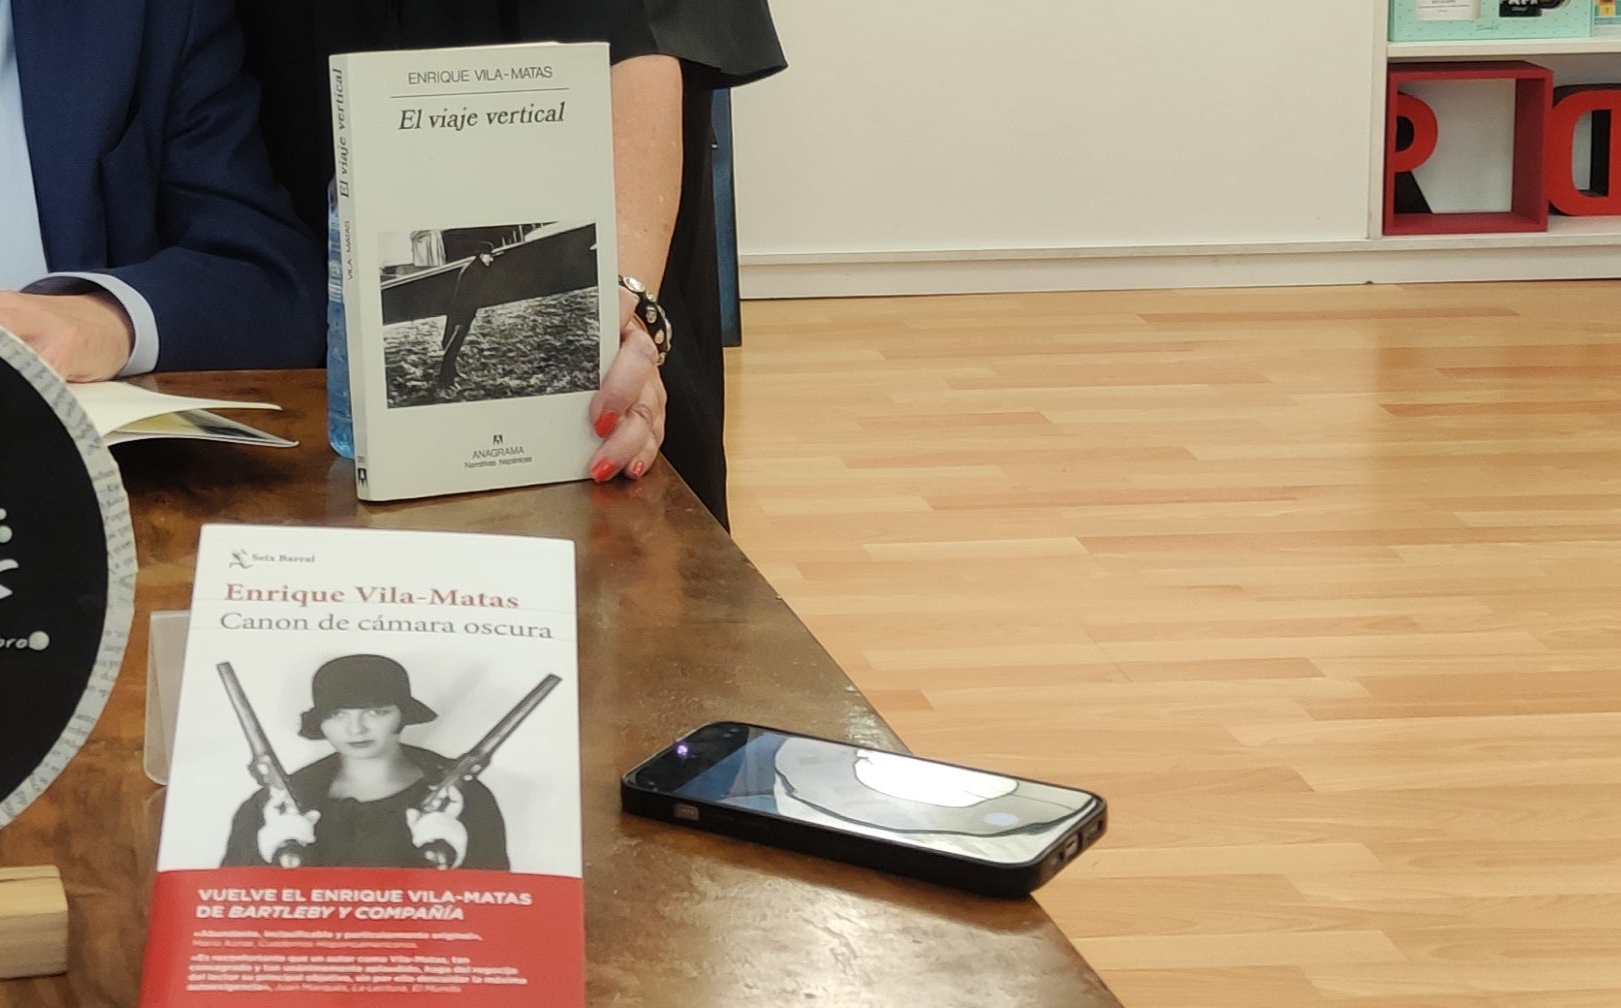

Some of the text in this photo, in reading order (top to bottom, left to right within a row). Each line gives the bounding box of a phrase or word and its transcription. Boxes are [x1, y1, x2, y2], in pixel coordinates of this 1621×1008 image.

[408, 65, 553, 85] ENRIQUE VILA-MATAS
[398, 101, 566, 132] El viaje vertical
[332, 67, 350, 199] El viaje vertical
[472, 446, 525, 459] ANAGRAMA
[251, 552, 316, 564] Seix Barral
[224, 583, 519, 609] Enrique Vila-Matas
[220, 612, 553, 640] Canon de cámara oscura
[198, 888, 533, 906] VUELVE EL ENRIQUE VILA-MATAS
[196, 904, 465, 921] DE BARTLEBY Y COMPAÑÍA
